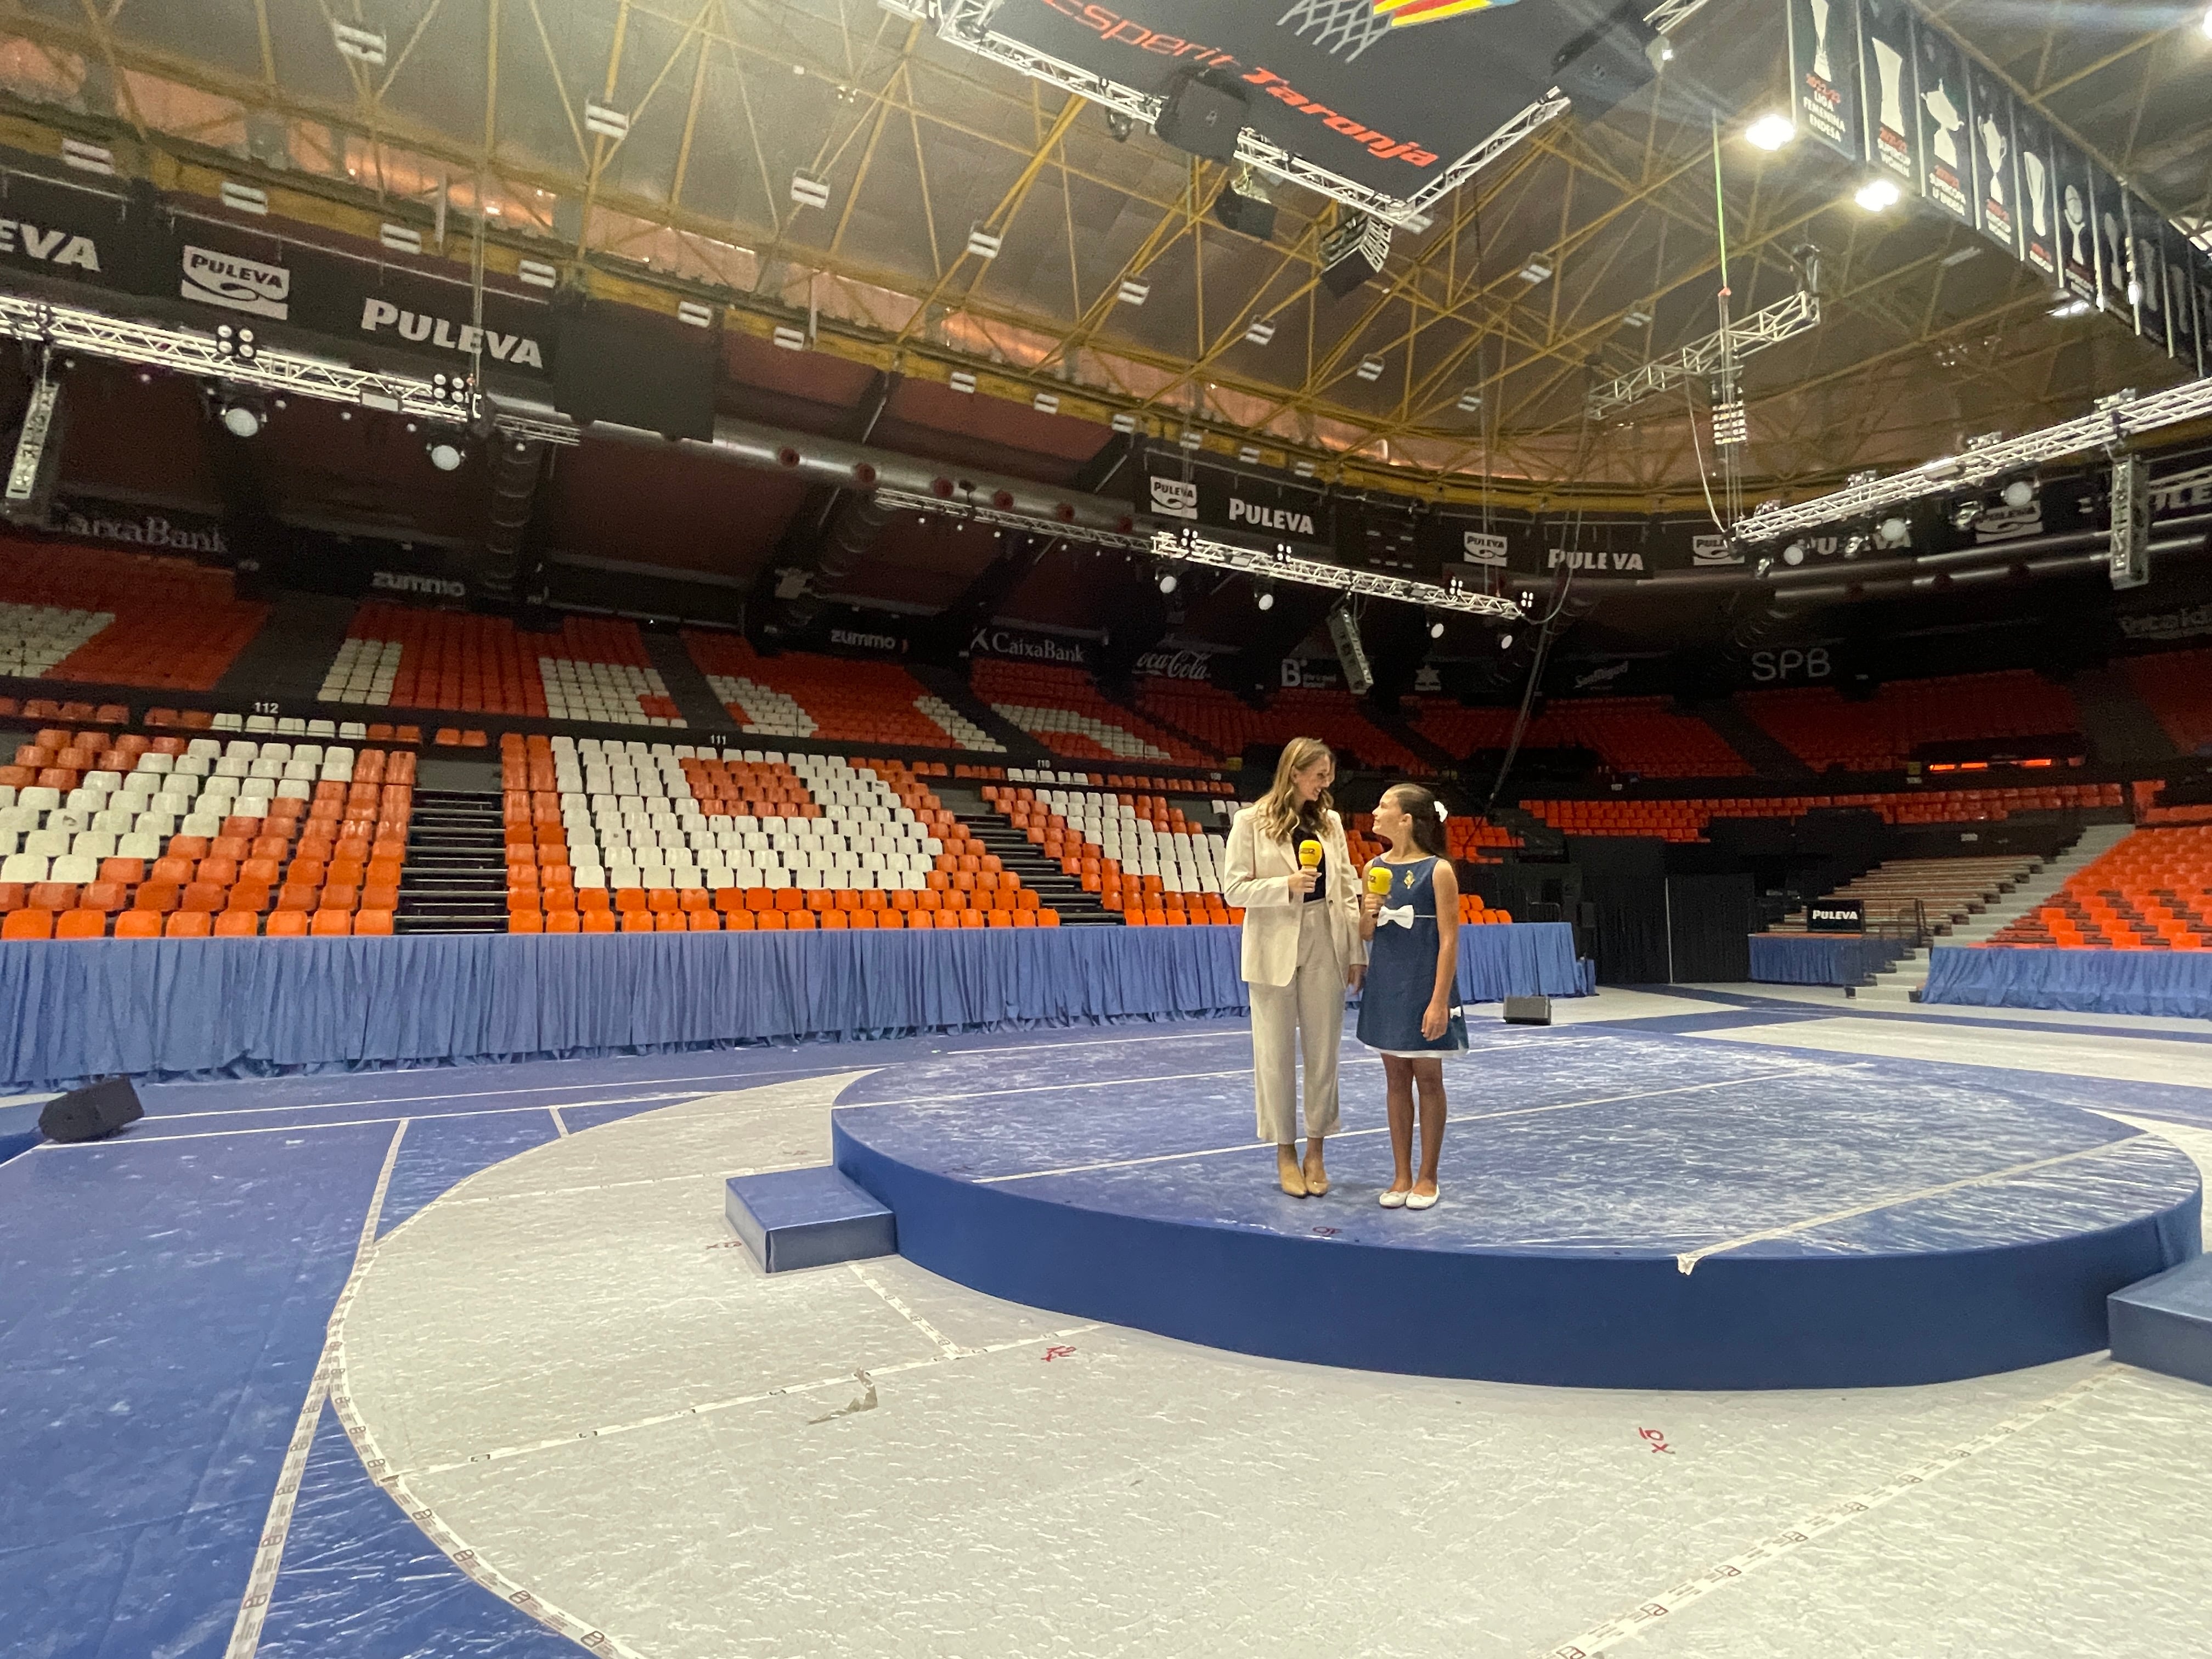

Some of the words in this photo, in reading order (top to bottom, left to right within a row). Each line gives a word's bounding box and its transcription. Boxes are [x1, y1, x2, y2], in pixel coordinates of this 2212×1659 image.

[1241, 66, 1440, 168] Taronja
[191, 254, 283, 289] PULEVA
[361, 298, 543, 369] PULEVA
[1154, 482, 1194, 498] PULEVA
[1229, 498, 1314, 535] PULEVA
[1467, 535, 1504, 548] PULEVA
[1547, 549, 1644, 571] PULEVA
[831, 629, 896, 650] zummo
[992, 631, 1085, 662] CaixaBank
[1751, 647, 1832, 681] SPB
[255, 702, 279, 714] 112
[709, 733, 727, 746] 111
[1812, 909, 1859, 920] PULEVA
